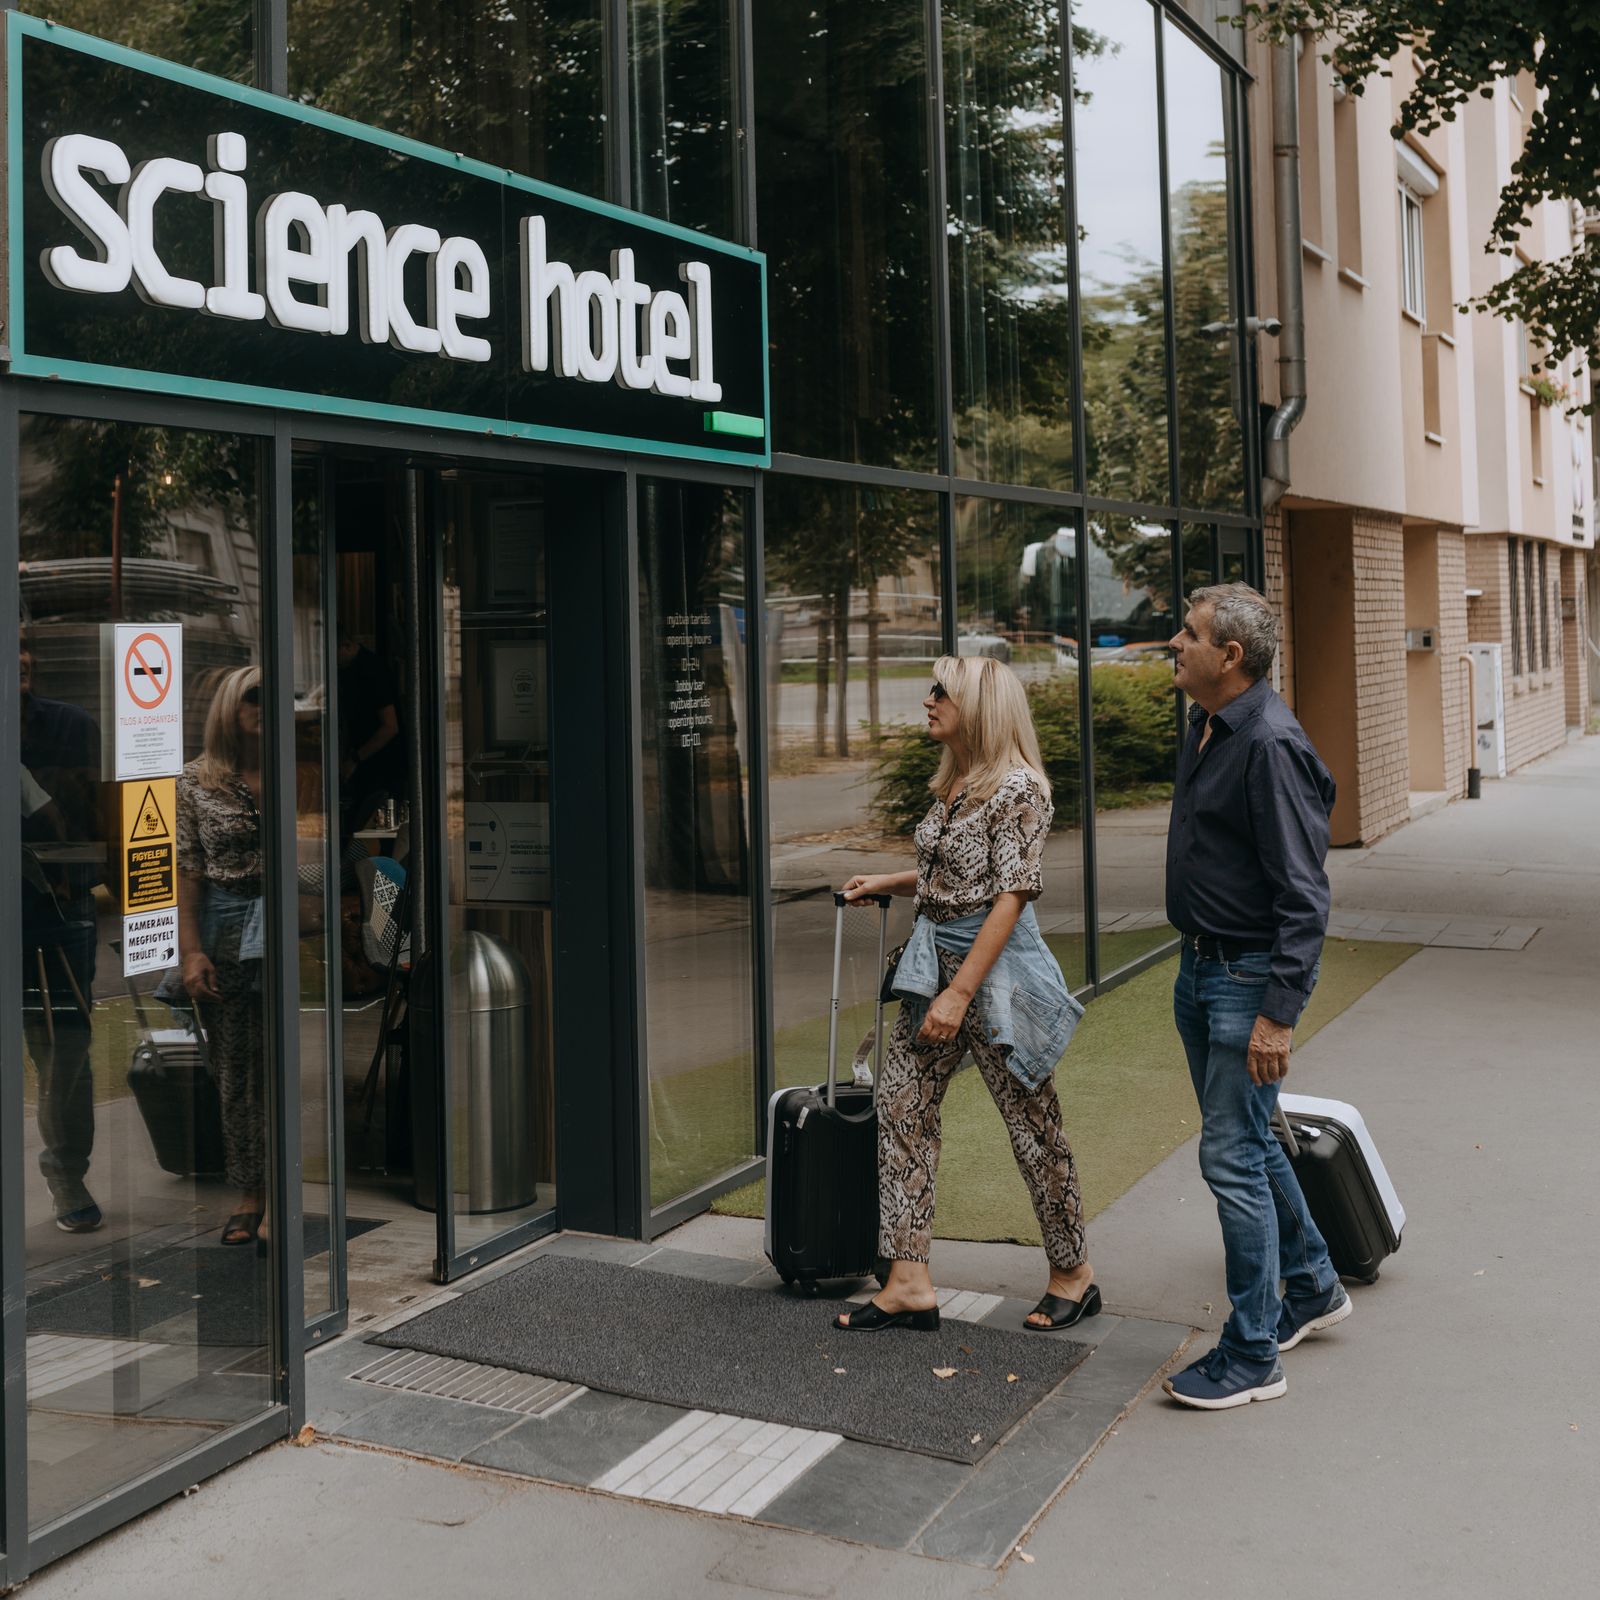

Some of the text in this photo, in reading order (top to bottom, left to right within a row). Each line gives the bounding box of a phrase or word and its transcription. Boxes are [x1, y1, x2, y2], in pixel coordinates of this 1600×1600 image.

[41, 131, 722, 402] science hotel
[667, 613, 689, 627] nyitva
[667, 633, 712, 647] opening hours
[675, 678, 705, 694] lobby bar
[120, 713, 178, 726] TILOS A DOHÁNYZÁS
[668, 713, 713, 730] opening hours
[132, 848, 168, 862] FIGYELEM!
[128, 915, 174, 932] KAMERÁVAL
[128, 930, 174, 947] MEGFIGYELT
[128, 947, 157, 962] TERÜLET!
